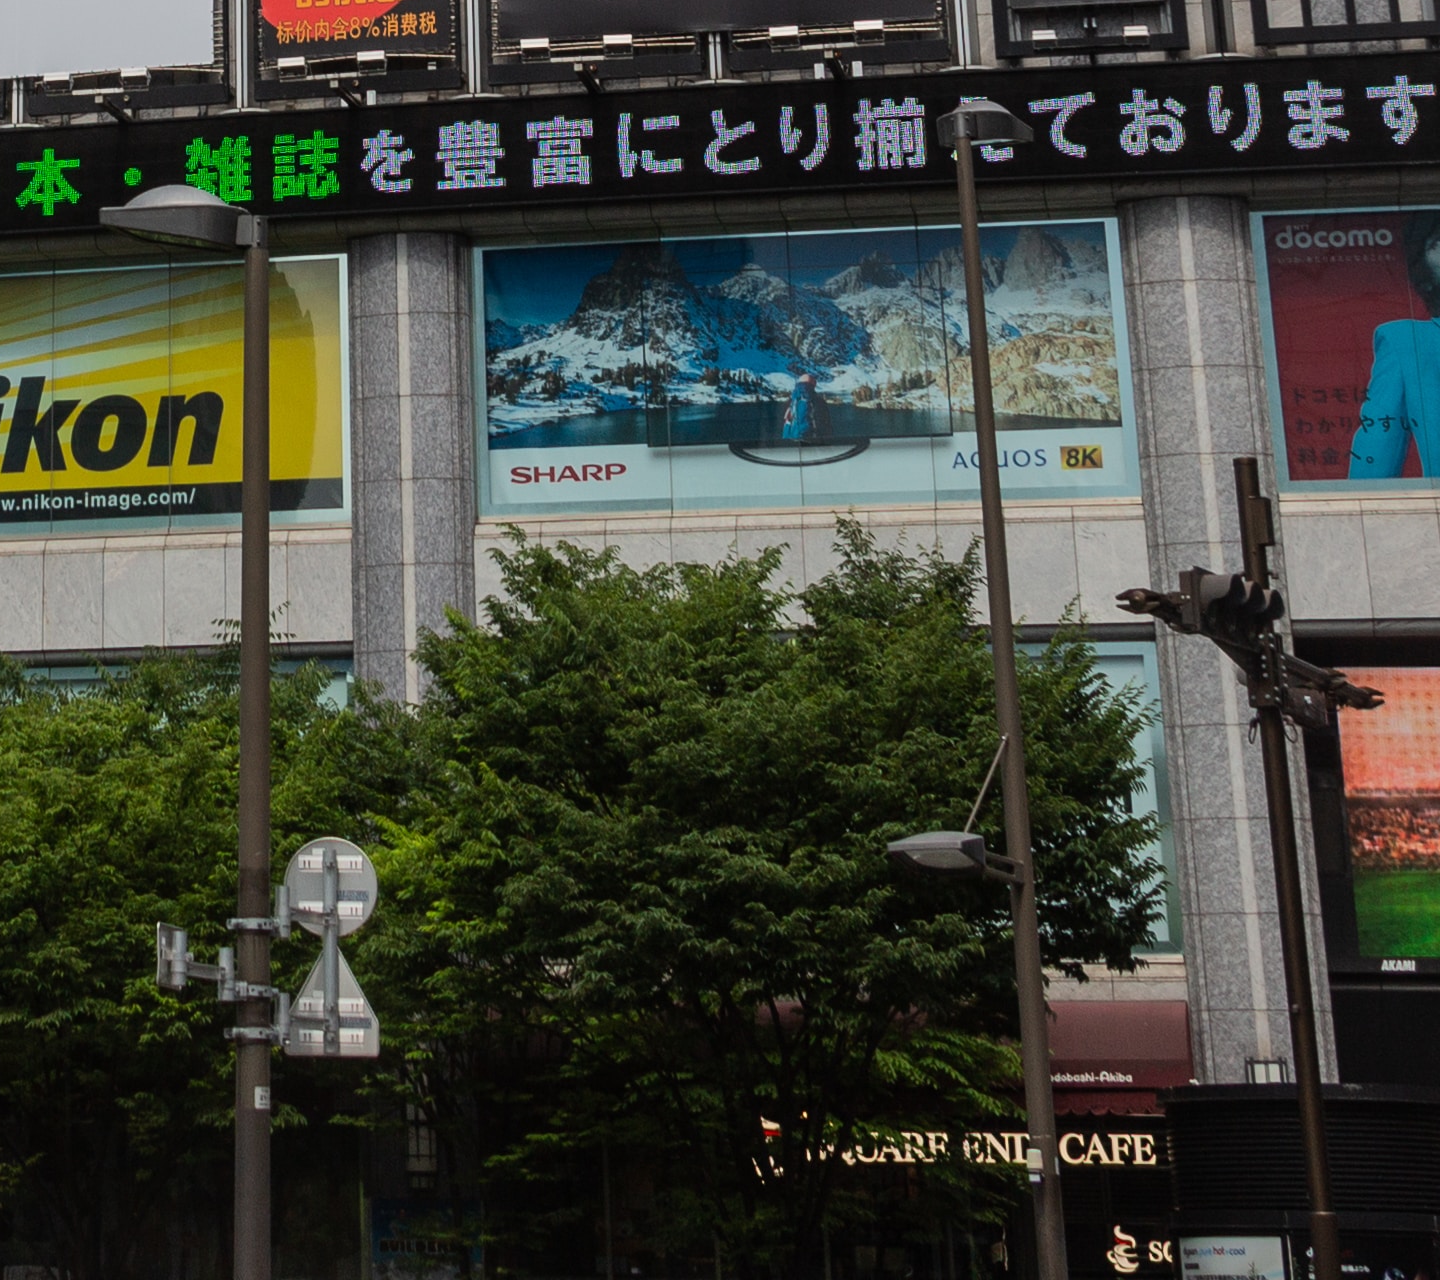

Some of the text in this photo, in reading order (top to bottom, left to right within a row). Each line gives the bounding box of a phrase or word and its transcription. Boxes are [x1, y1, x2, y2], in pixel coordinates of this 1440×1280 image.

[275, 11, 439, 46] 标价内含8%消费税
[1275, 226, 1394, 250] docomo
[1293, 387, 1371, 405] ドコモは
[1295, 414, 1420, 435] わかりやすい
[509, 459, 628, 486] SHARP
[1380, 958, 1416, 973] AKAMI
[1058, 1133, 1158, 1167] CAFE
